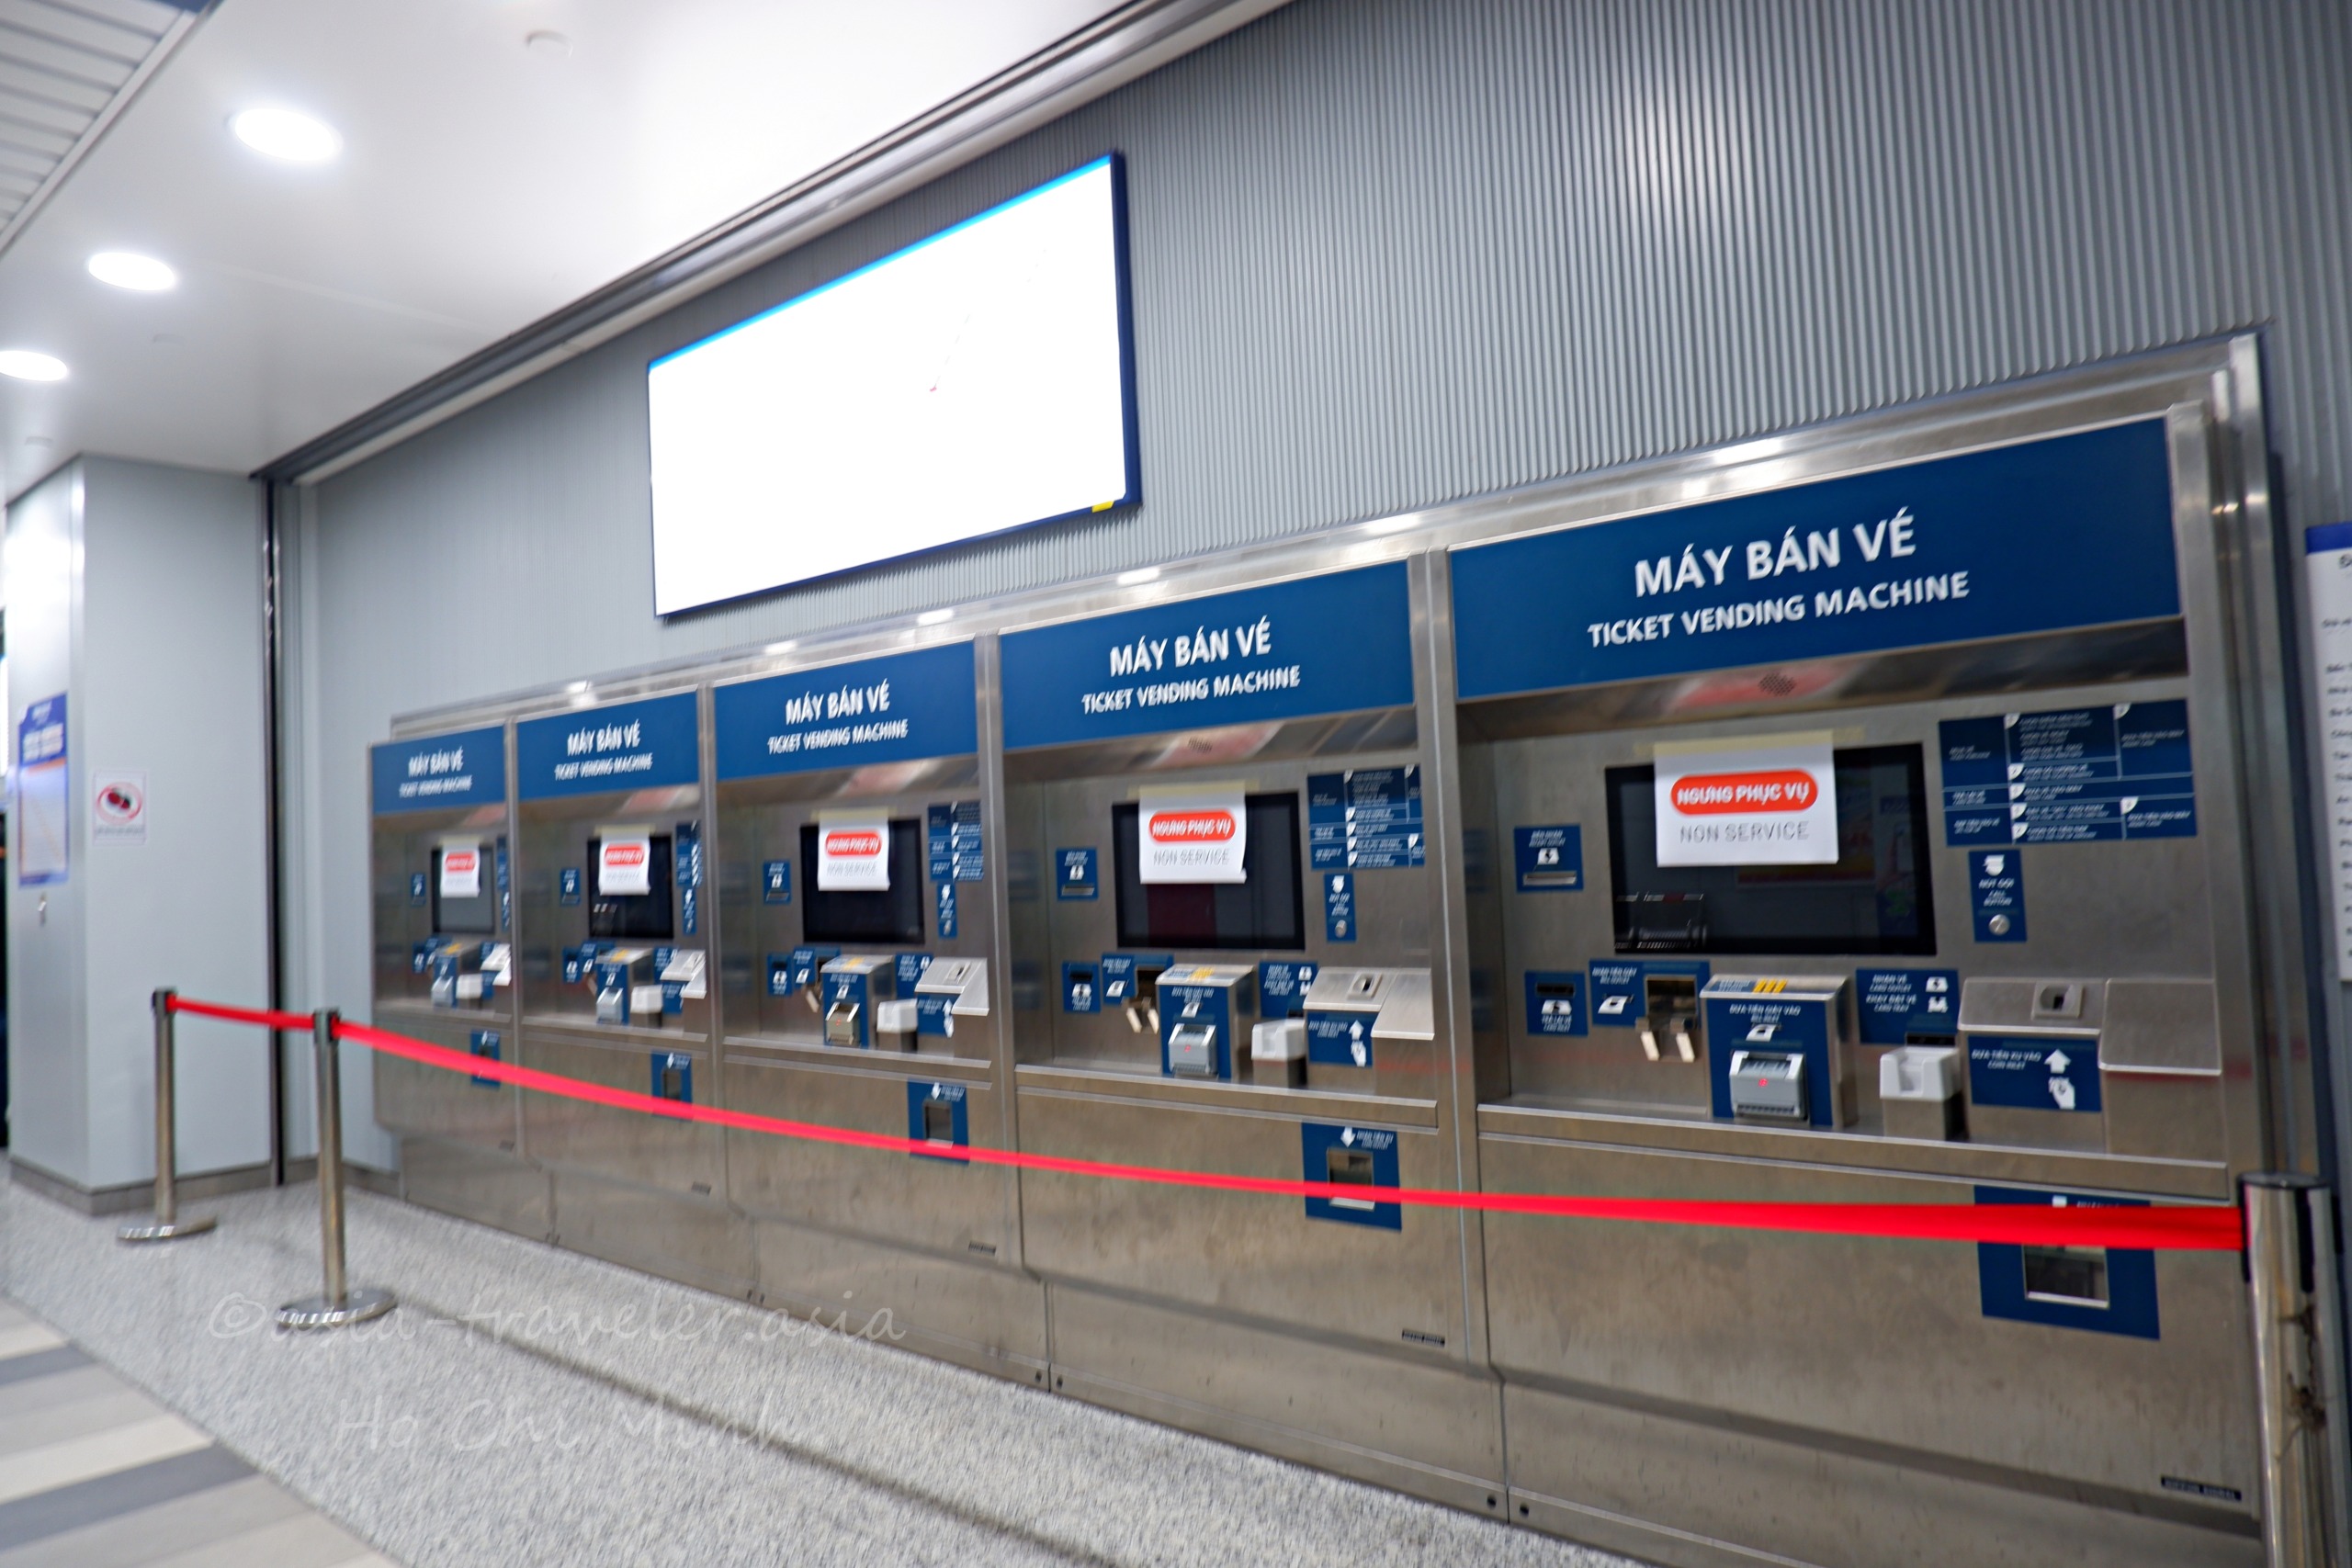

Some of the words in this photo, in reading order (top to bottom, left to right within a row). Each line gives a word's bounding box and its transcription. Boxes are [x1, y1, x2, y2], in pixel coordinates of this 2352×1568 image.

[1634, 543, 1733, 598] MÁY
[1747, 525, 1841, 580] BÁN
[1852, 505, 1916, 563] VÉ
[1588, 612, 1674, 648] TICKET
[1681, 593, 1805, 636] VENDING
[1815, 570, 1971, 618] MACHINE
[1109, 635, 1169, 677] MÁY
[1174, 625, 1229, 668] BÁN
[1235, 615, 1272, 657] VÉ
[785, 690, 824, 726] MÁY
[827, 684, 864, 719] BÁN
[866, 678, 891, 714] VÉ
[1080, 687, 1132, 714] TICKET
[1136, 677, 1209, 708] VENDING
[1213, 664, 1301, 697] MACHINE
[767, 732, 801, 755] TICKET
[803, 726, 851, 750] VENDING
[852, 717, 910, 744] MACHINE
[1735, 783, 1782, 806] PHỤC
[1784, 781, 1811, 804] VỤ
[1679, 823, 1719, 843] NON
[1724, 819, 1811, 842] SERVICE
[1153, 849, 1178, 866] NON
[1180, 847, 1230, 866] SERVICE
